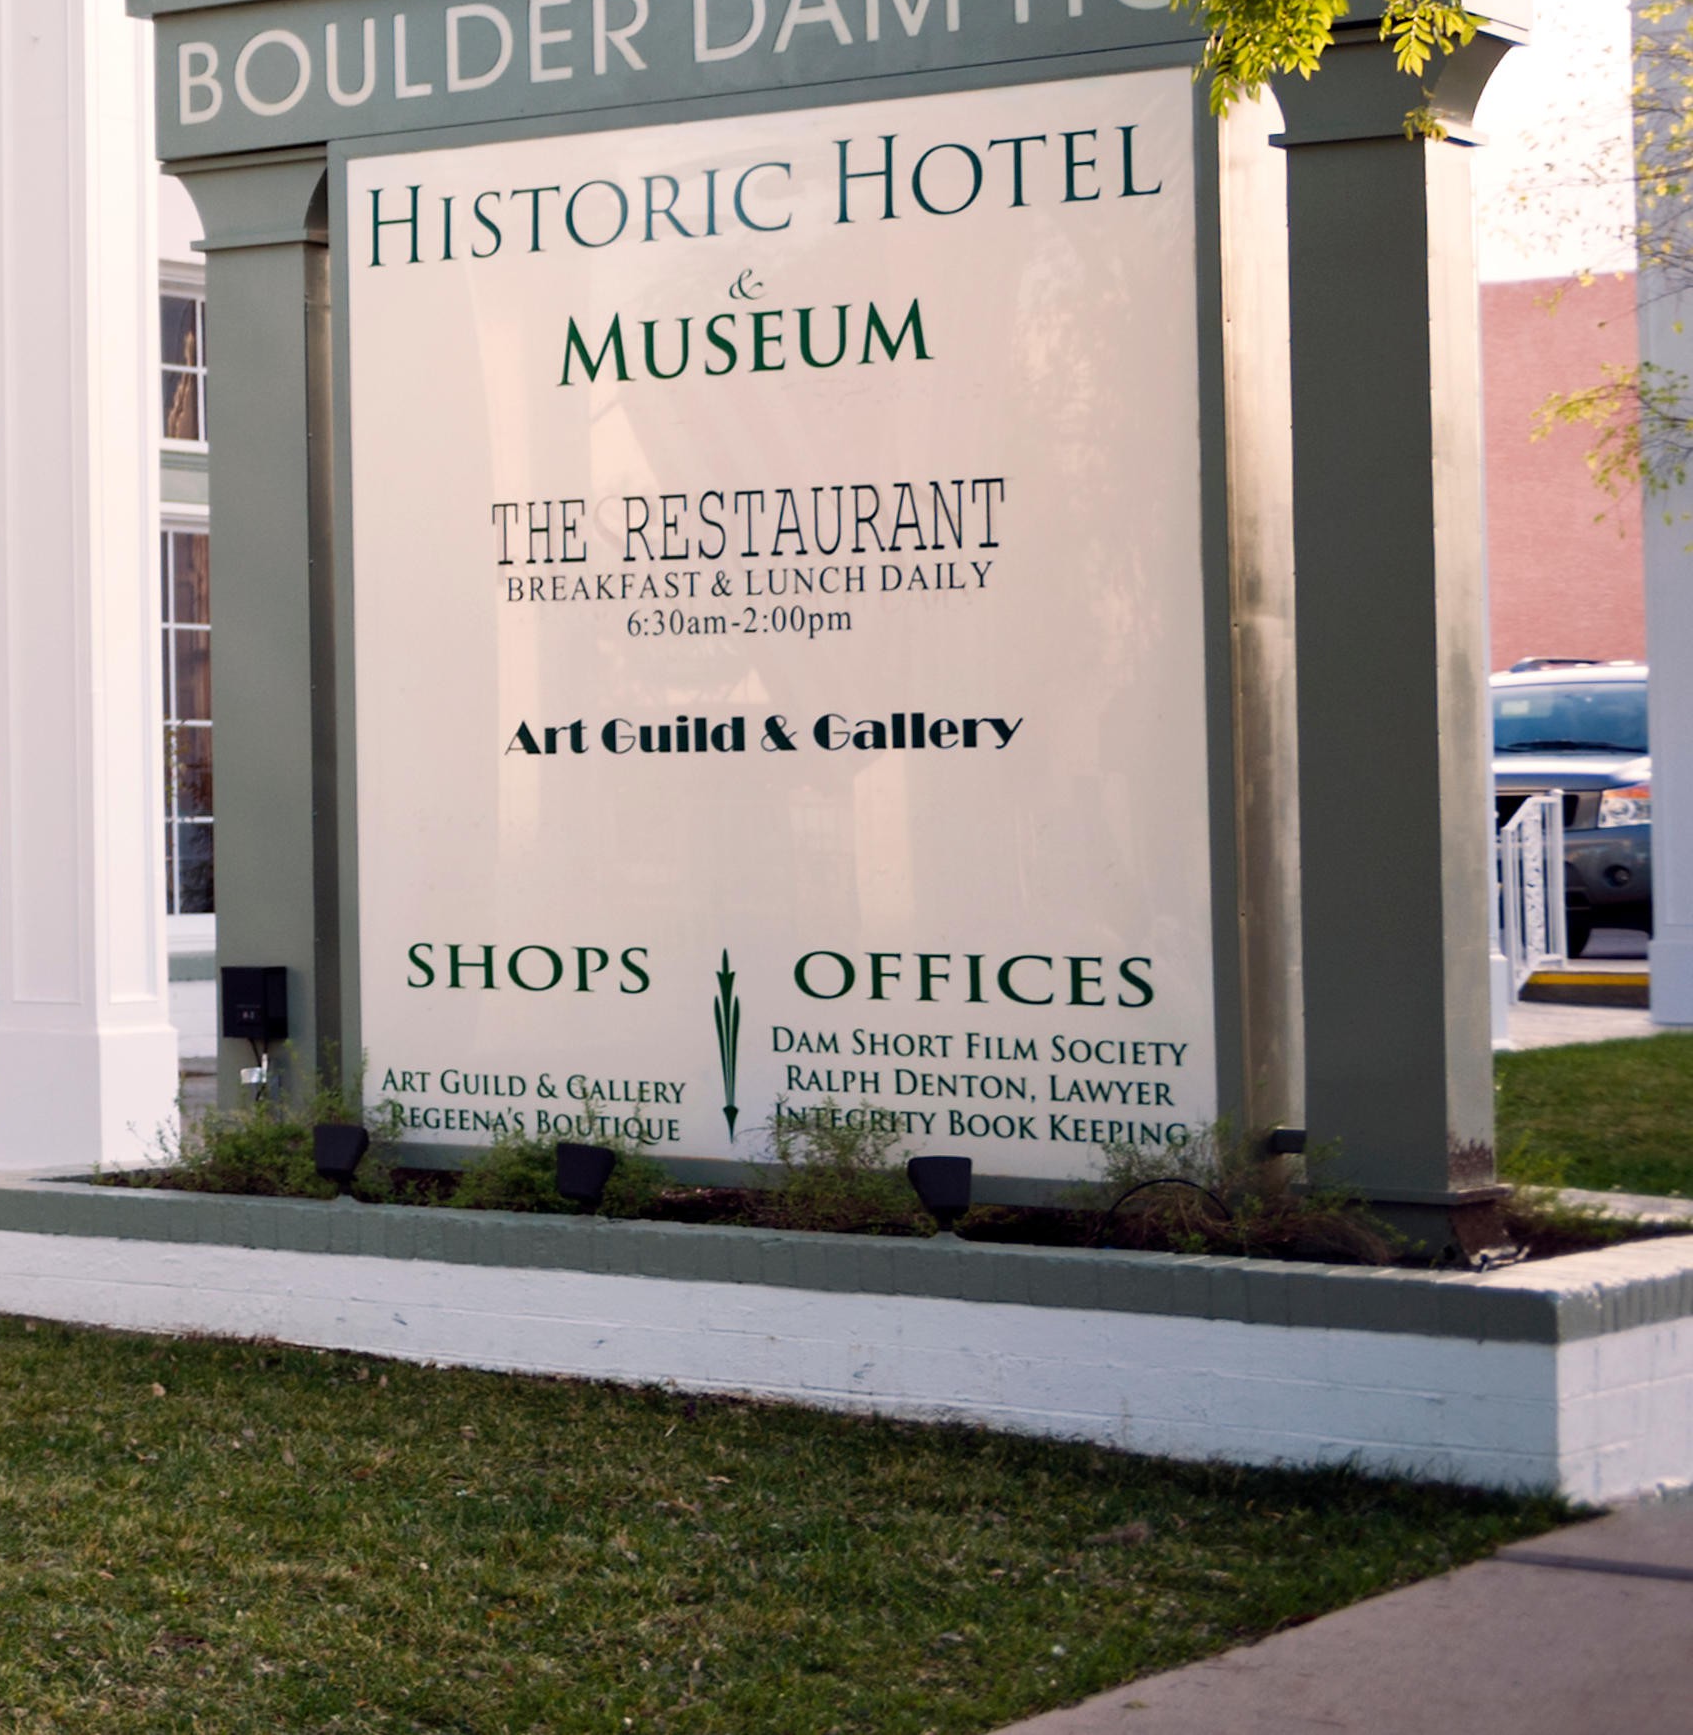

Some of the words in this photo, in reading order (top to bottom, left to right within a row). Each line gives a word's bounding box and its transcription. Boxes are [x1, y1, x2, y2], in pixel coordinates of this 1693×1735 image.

[366, 161, 793, 267] HISTORIC
[832, 124, 1164, 225] HOTEL
[728, 268, 765, 302] &
[556, 297, 935, 388] MUSEUM
[491, 498, 588, 566] THE
[622, 477, 1006, 562] RESTAURANT
[506, 571, 702, 603] BREAKFAST
[711, 571, 734, 598] &
[745, 565, 867, 597] LUNCH
[880, 561, 995, 592] DAILY
[626, 605, 853, 639] 6:30am-2:00pm
[503, 719, 589, 755] Art
[601, 714, 746, 755] Guild
[759, 714, 798, 752] &
[813, 712, 1024, 751] Gallery
[406, 942, 651, 995] SHOPS
[793, 950, 1155, 1009] OFFICES
[771, 1025, 841, 1055] DAM
[851, 1028, 953, 1061] SHORT
[966, 1032, 1039, 1062] FILM
[1050, 1035, 1190, 1068] SOCIETY
[381, 1067, 431, 1093] ART
[439, 1069, 527, 1098] GUILD
[535, 1072, 560, 1100] &
[566, 1074, 687, 1105] GALLERY
[786, 1064, 881, 1095] RALPH
[894, 1068, 1037, 1103] DENTON,
[1049, 1074, 1175, 1108] LAWYER
[391, 1102, 525, 1135] REGEENA'S
[535, 1109, 682, 1146] BOUTIQUE
[775, 1103, 937, 1136] INTEGRITY
[948, 1111, 1040, 1142] BOOK
[1050, 1114, 1189, 1148] KEEPING
